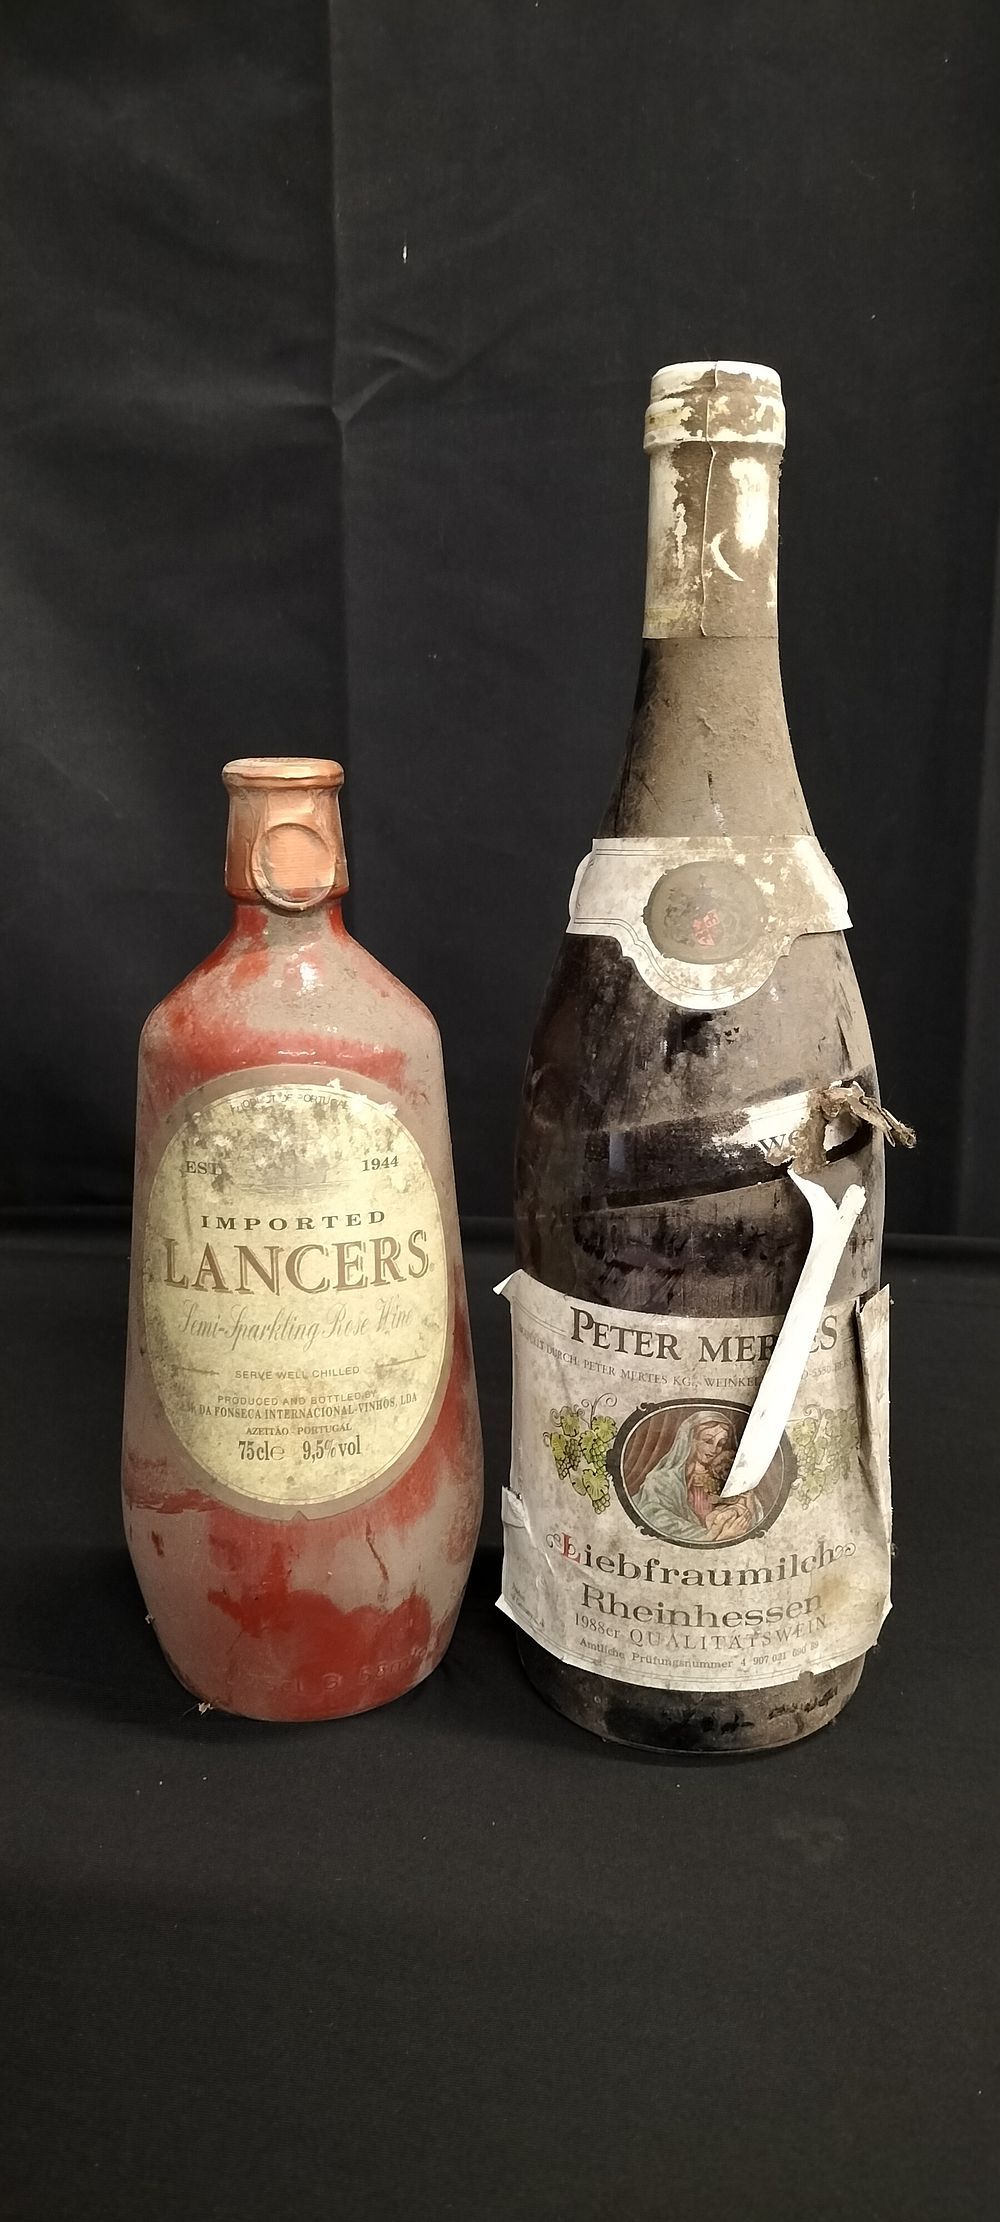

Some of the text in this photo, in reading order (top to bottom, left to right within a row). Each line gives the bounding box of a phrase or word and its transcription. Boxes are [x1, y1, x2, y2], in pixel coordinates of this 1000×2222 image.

[362, 1156, 399, 1172] 1944
[201, 1211, 386, 1231] IMPORTED
[163, 1229, 430, 1297] LANCERS
[178, 1299, 320, 1352] Semi-Sparkling
[570, 1306, 682, 1361] PETER
[698, 1315, 838, 1363] MERS
[235, 1366, 360, 1380] SERVE WELL CHILLED
[583, 1359, 616, 1377] PETER
[620, 1368, 669, 1385] MERTES
[214, 1406, 261, 1420] FONSECA
[400, 1392, 417, 1406] LDA
[217, 1395, 278, 1406] PRODUCED
[282, 1396, 306, 1406] AND
[310, 1392, 361, 1405] BOTTLED
[246, 1426, 289, 1436] AZEITÃO
[302, 1439, 337, 1463] 9,5%
[338, 1434, 362, 1457] vol
[561, 1531, 836, 1587] Liebfraumilch
[581, 1582, 823, 1629] Rheinhessen
[574, 1612, 621, 1639] 1988er
[630, 1614, 827, 1651] QUALITÄTSWEIN
[580, 1637, 625, 1660] Amtliche
[631, 1651, 733, 1670] Prüfungsnummer
[740, 1657, 747, 1667] 4
[753, 1654, 770, 1666] 907
